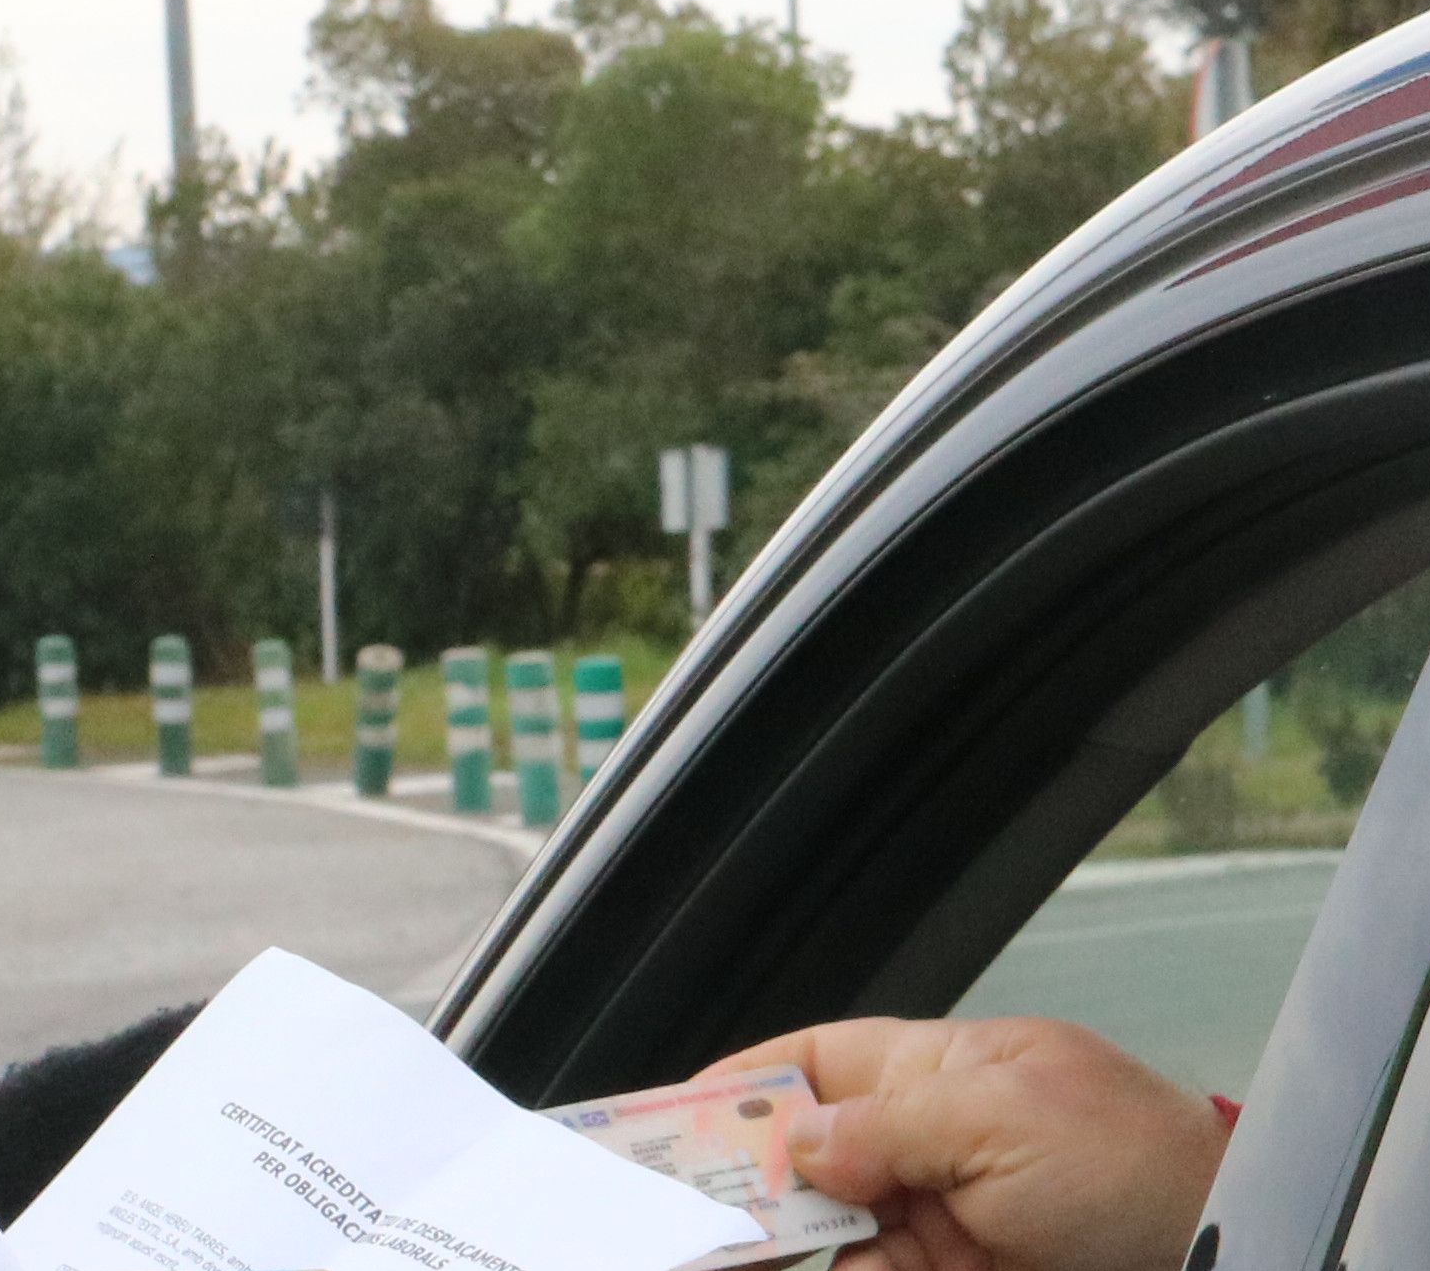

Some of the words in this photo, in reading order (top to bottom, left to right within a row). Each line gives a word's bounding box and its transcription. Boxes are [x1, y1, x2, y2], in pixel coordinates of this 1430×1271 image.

[220, 1102, 304, 1155] CERTIFICAT
[297, 1152, 399, 1227] ACREDITA
[253, 1151, 287, 1178] PER
[380, 1233, 450, 1271] LABORALS
